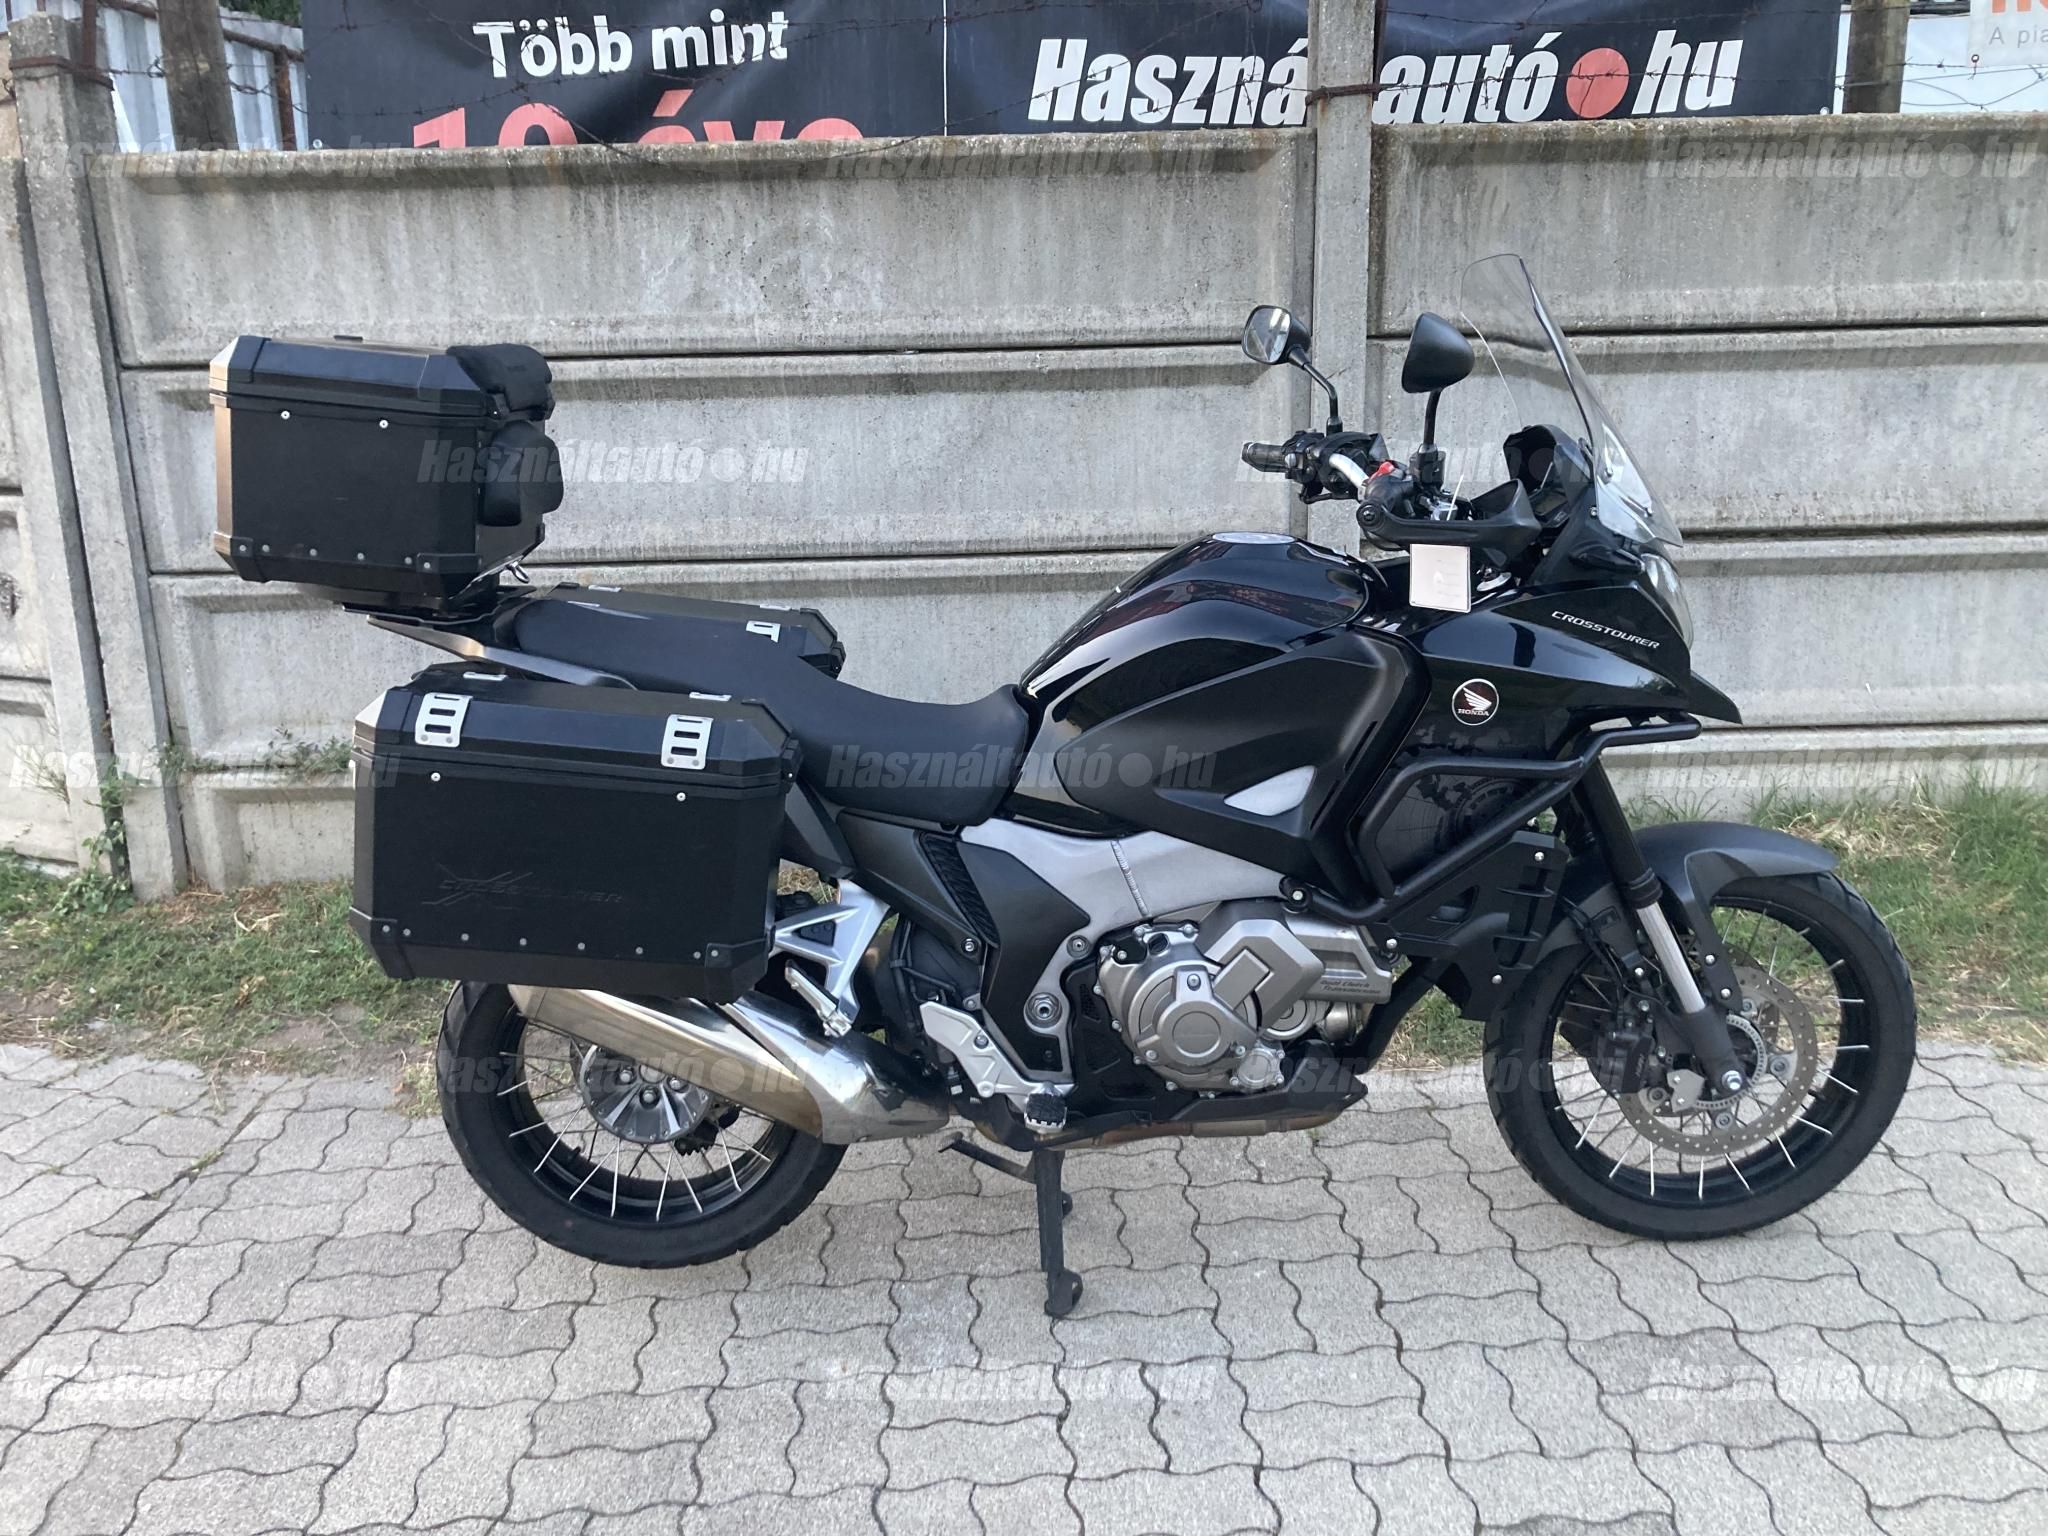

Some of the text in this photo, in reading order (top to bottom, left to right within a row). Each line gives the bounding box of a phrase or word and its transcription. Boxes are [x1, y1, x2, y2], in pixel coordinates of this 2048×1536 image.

[473, 9, 789, 78] Több mint
[1988, 26, 2005, 45] A
[1551, 610, 1660, 649] CROSSTOURER
[1457, 708, 1490, 716] HONDA
